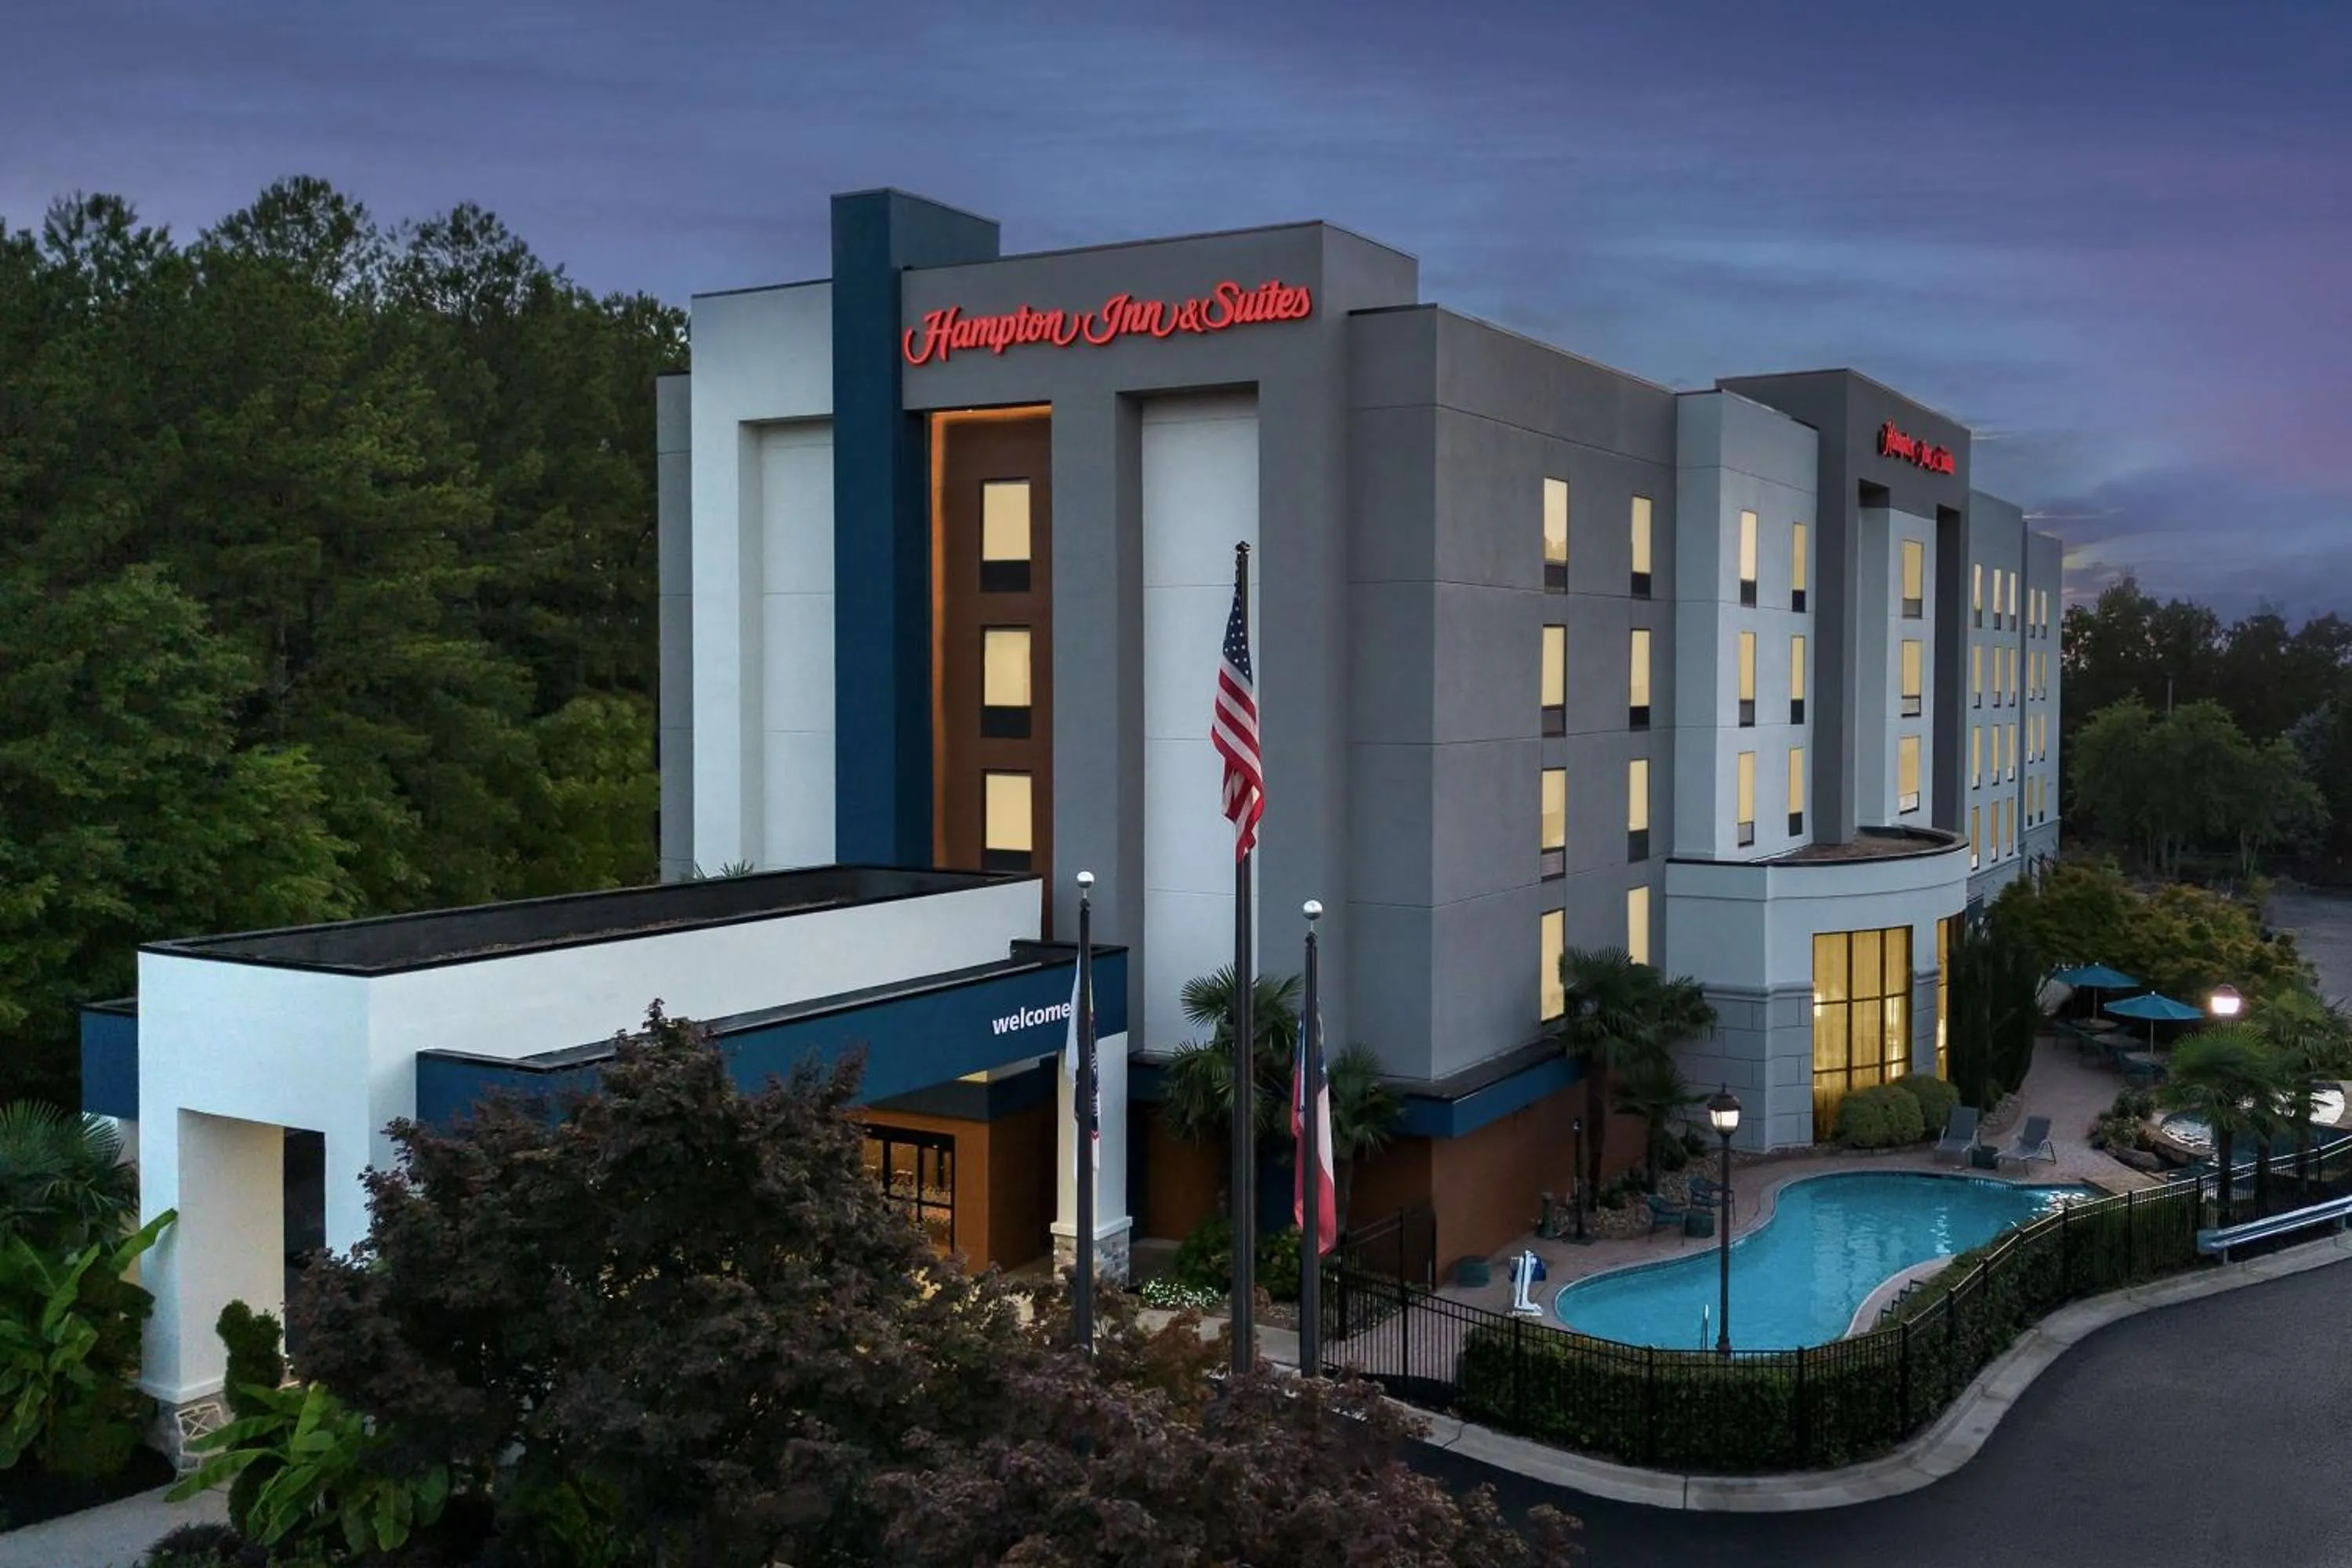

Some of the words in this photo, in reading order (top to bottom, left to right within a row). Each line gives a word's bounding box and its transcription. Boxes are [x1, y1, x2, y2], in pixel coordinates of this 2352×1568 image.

[903, 304, 1080, 365] Hampton
[1083, 293, 1180, 345] Inn
[1178, 299, 1205, 333] &
[1201, 280, 1311, 328] Suites
[992, 1002, 1072, 1035] welcome
